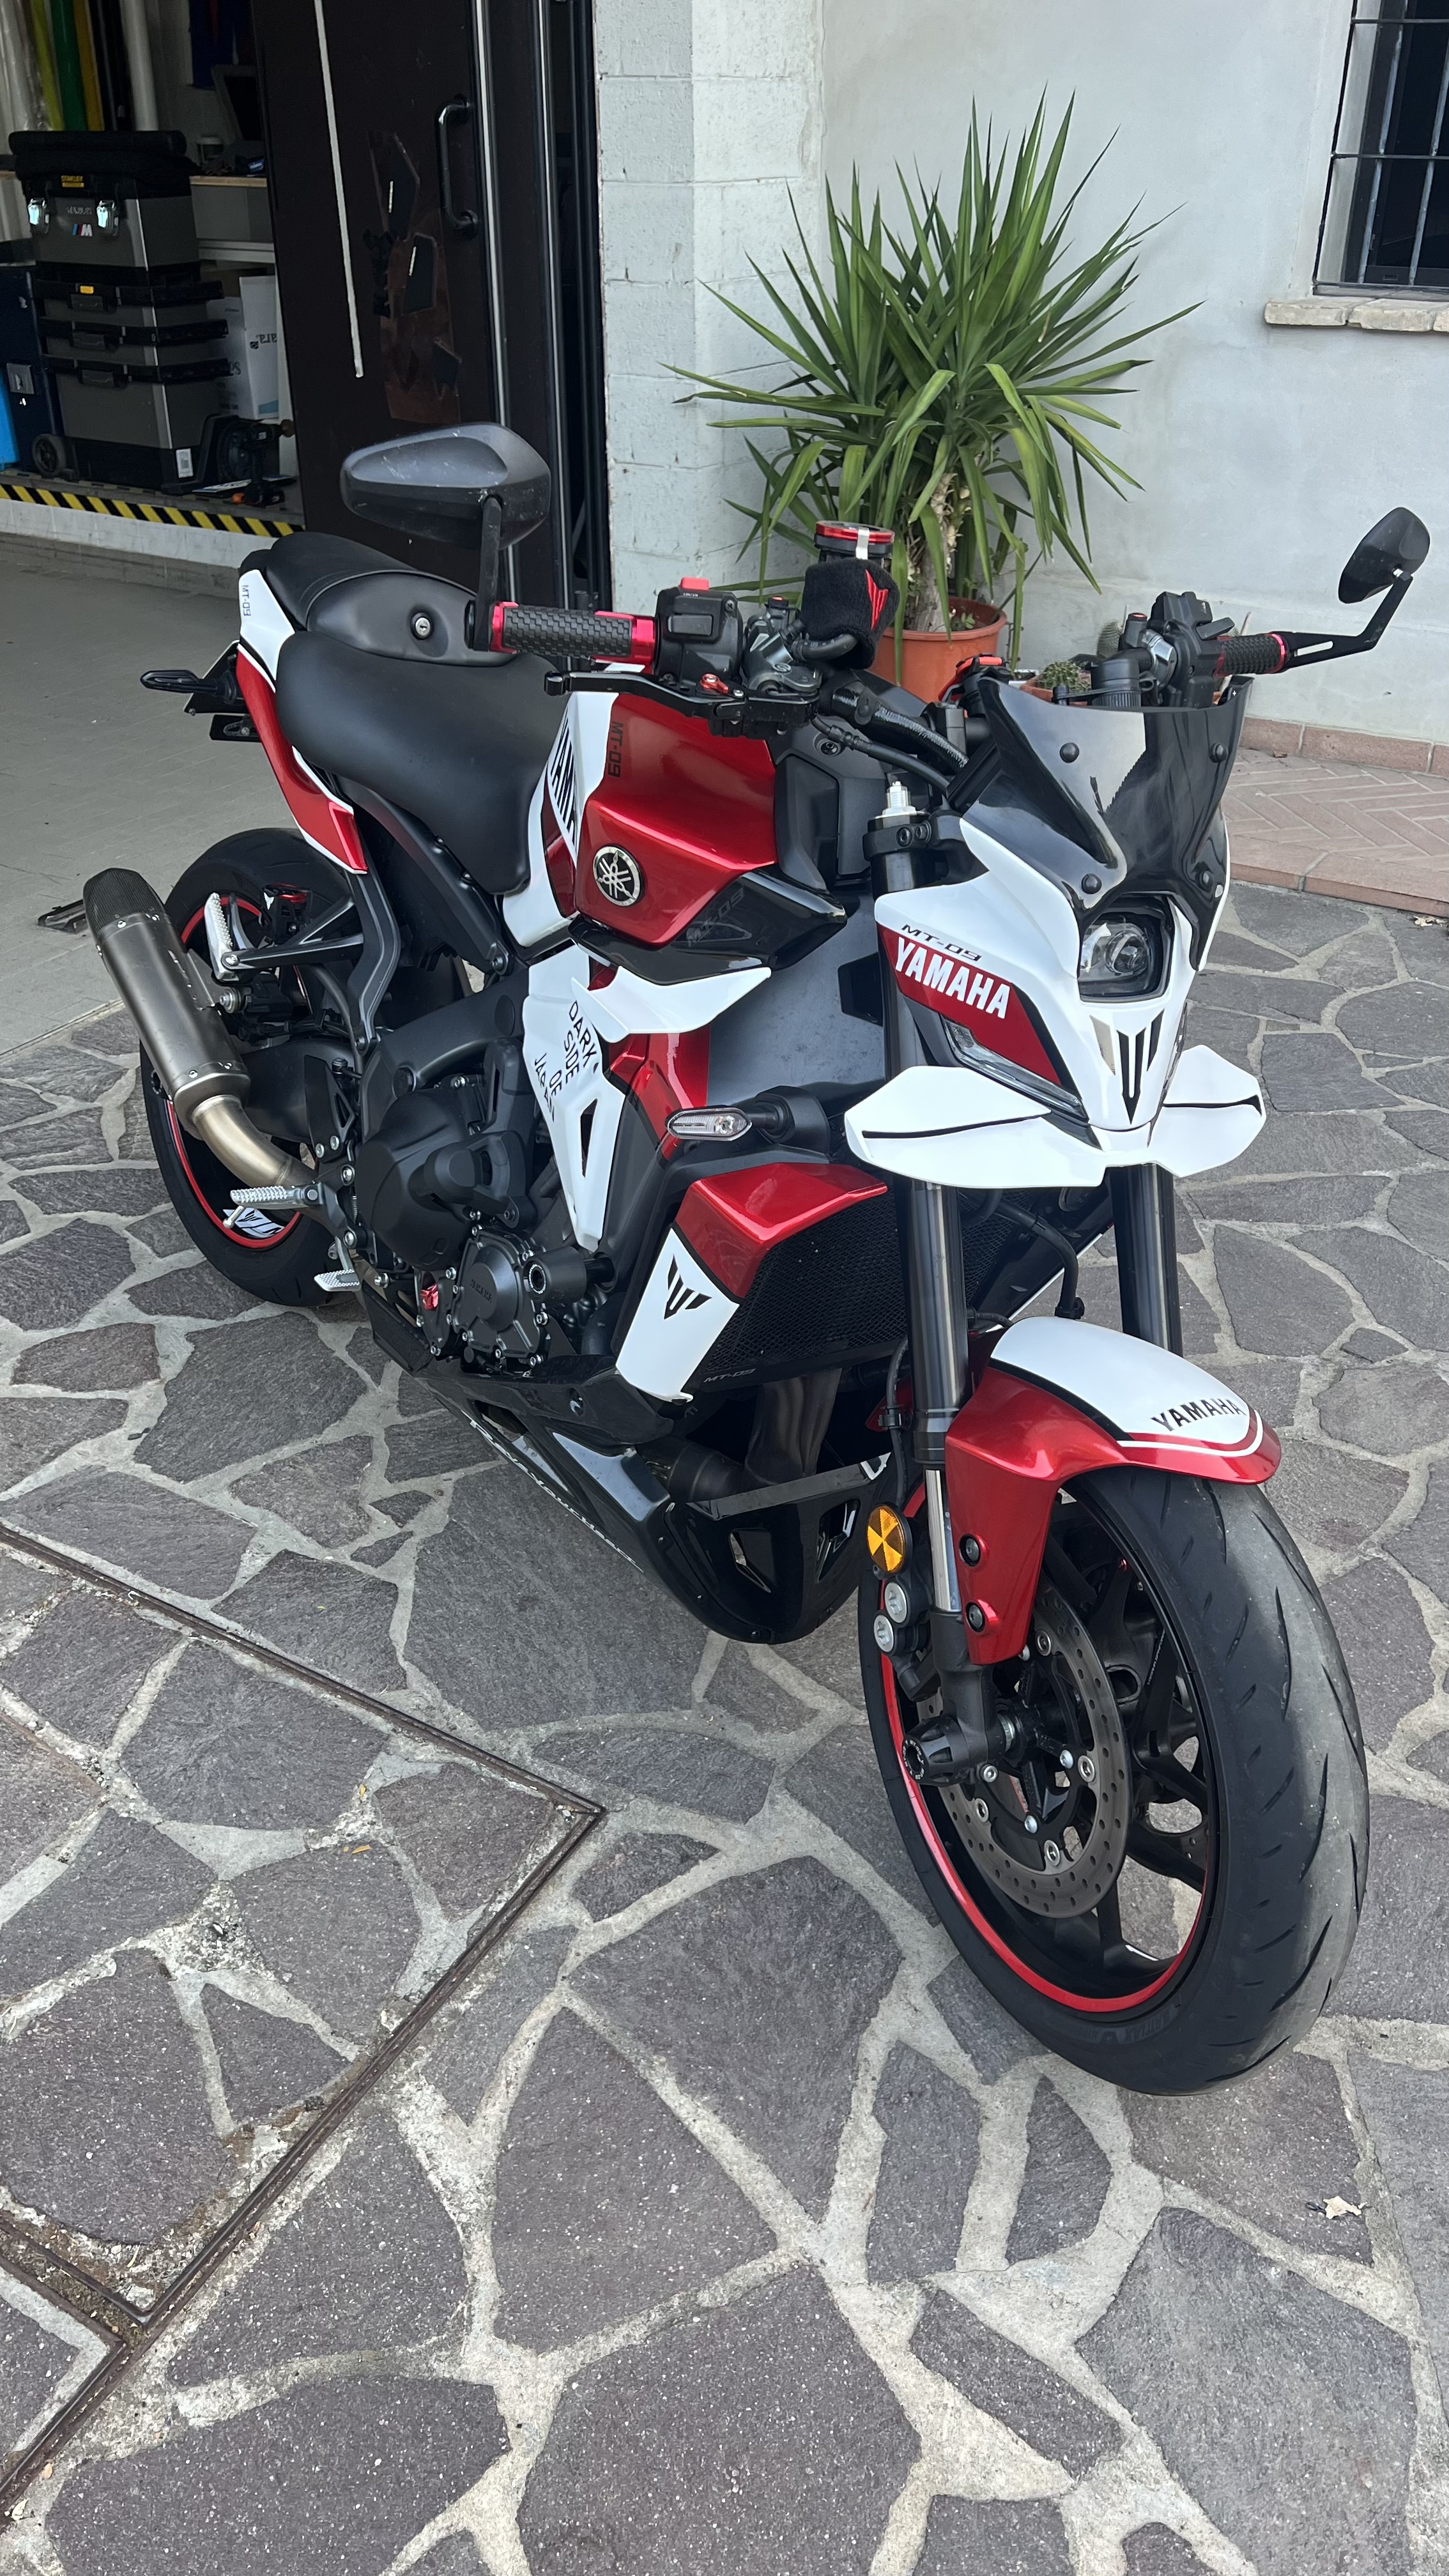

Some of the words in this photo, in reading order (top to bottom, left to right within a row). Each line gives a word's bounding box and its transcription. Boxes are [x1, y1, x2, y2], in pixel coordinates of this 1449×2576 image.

[241, 585, 251, 617] MT-09
[608, 721, 624, 778] MT-09
[901, 924, 982, 962] MT-09
[895, 936, 1011, 1019] YAMAHA
[569, 1000, 597, 1068] DARK
[564, 1030, 579, 1085] SIDE
[535, 1052, 555, 1123] JAPAN
[549, 1070, 562, 1096] OF
[703, 1368, 756, 1383] MT-09
[1150, 1398, 1247, 1432] YAMAHA
